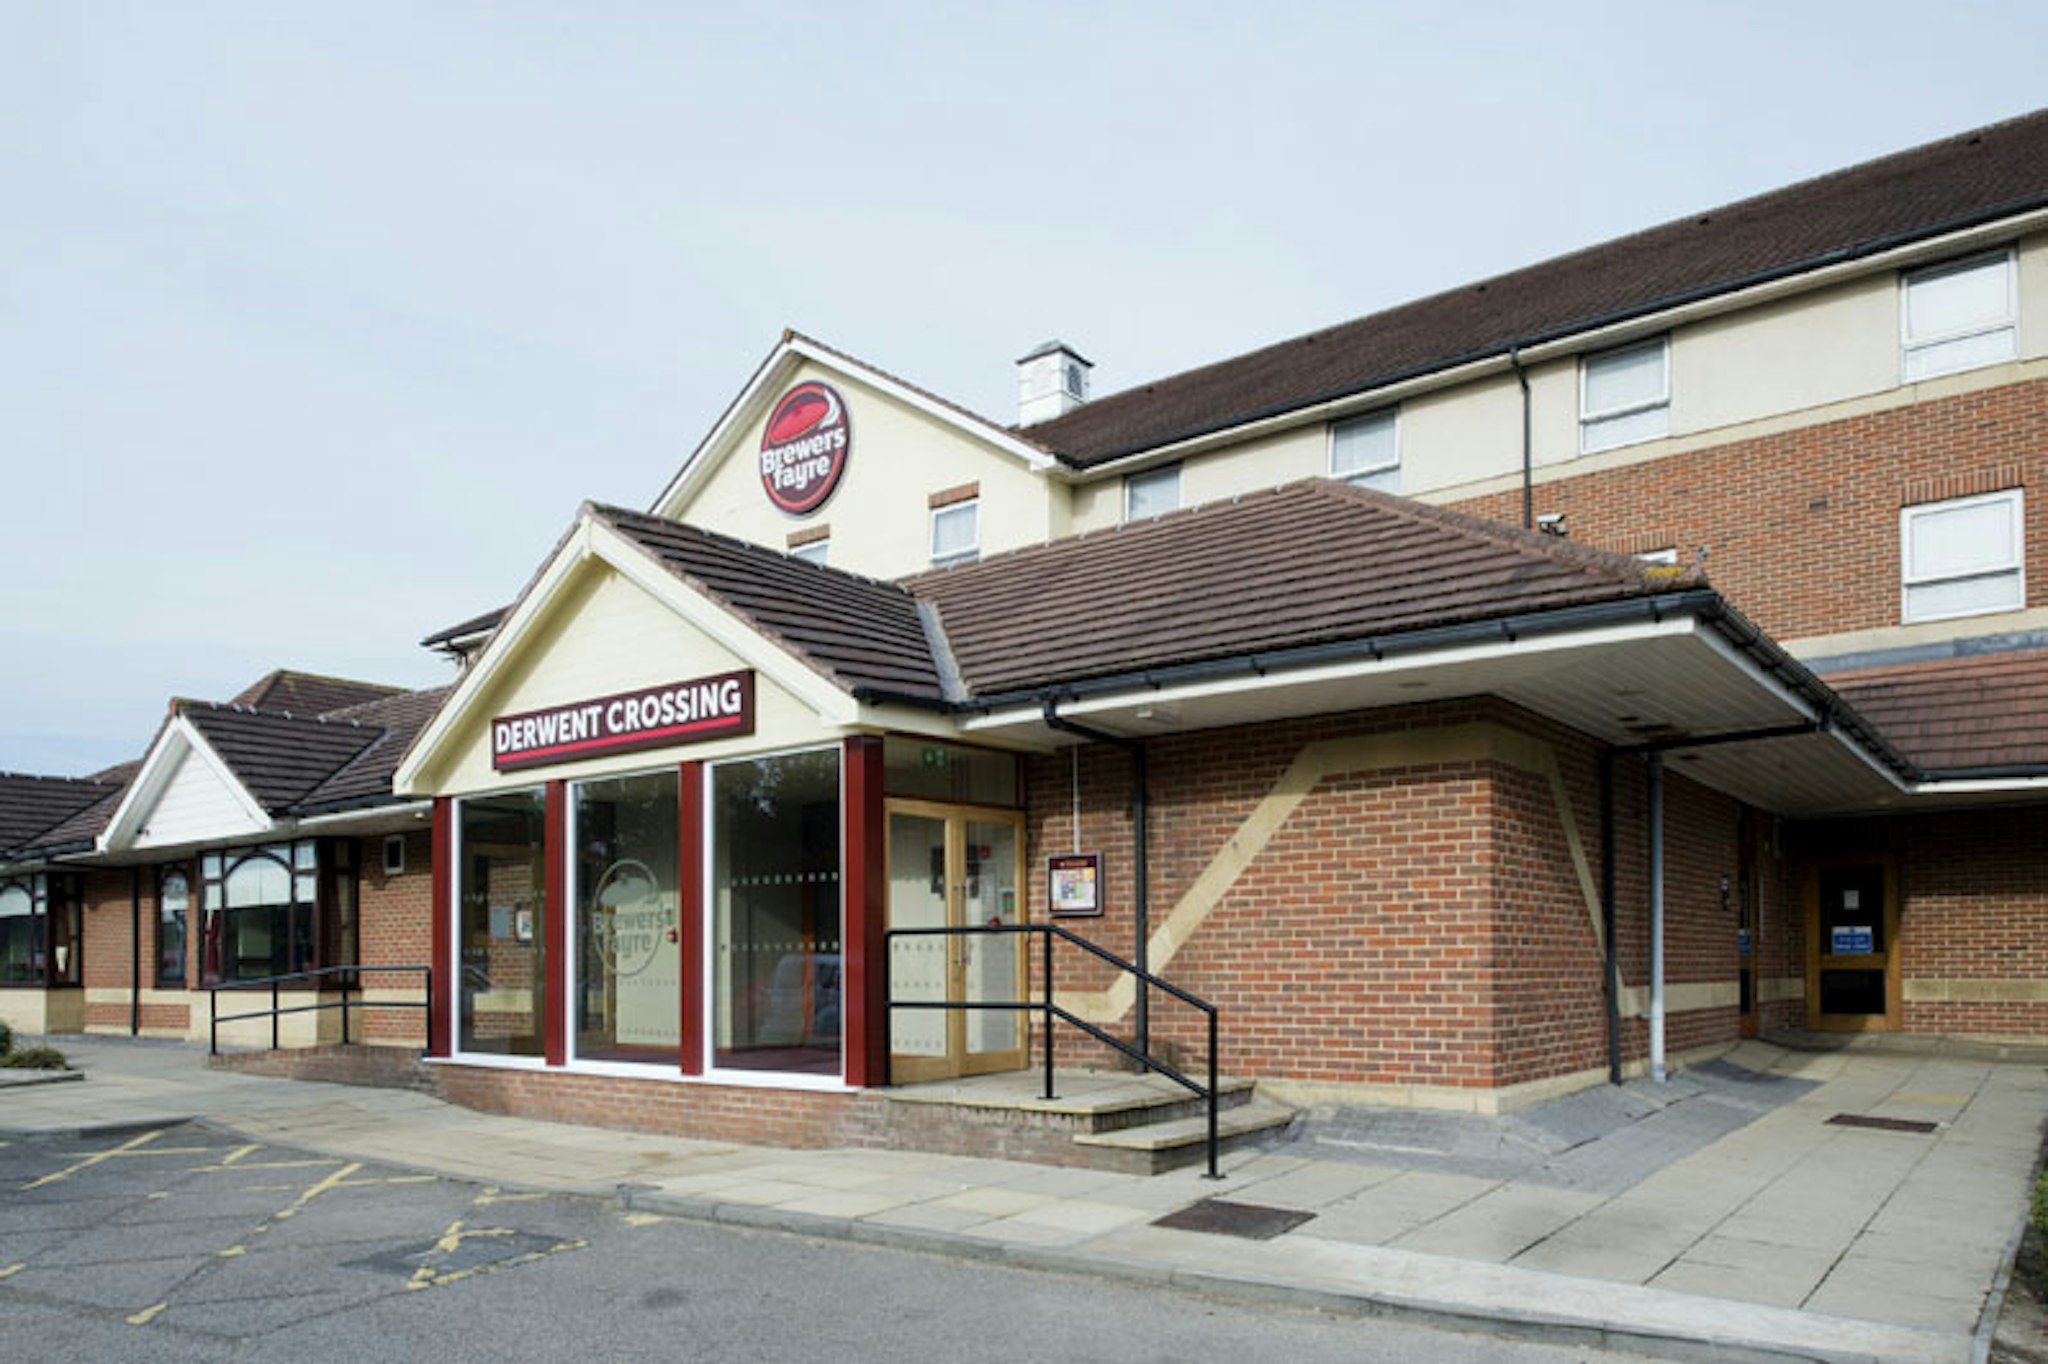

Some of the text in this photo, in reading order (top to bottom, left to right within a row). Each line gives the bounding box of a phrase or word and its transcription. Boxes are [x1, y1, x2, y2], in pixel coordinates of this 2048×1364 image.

[761, 428, 846, 476] Brewers
[495, 679, 742, 753] DERWENT CROSSING
[593, 910, 664, 934] Bewers
[603, 933, 652, 959] ayre
